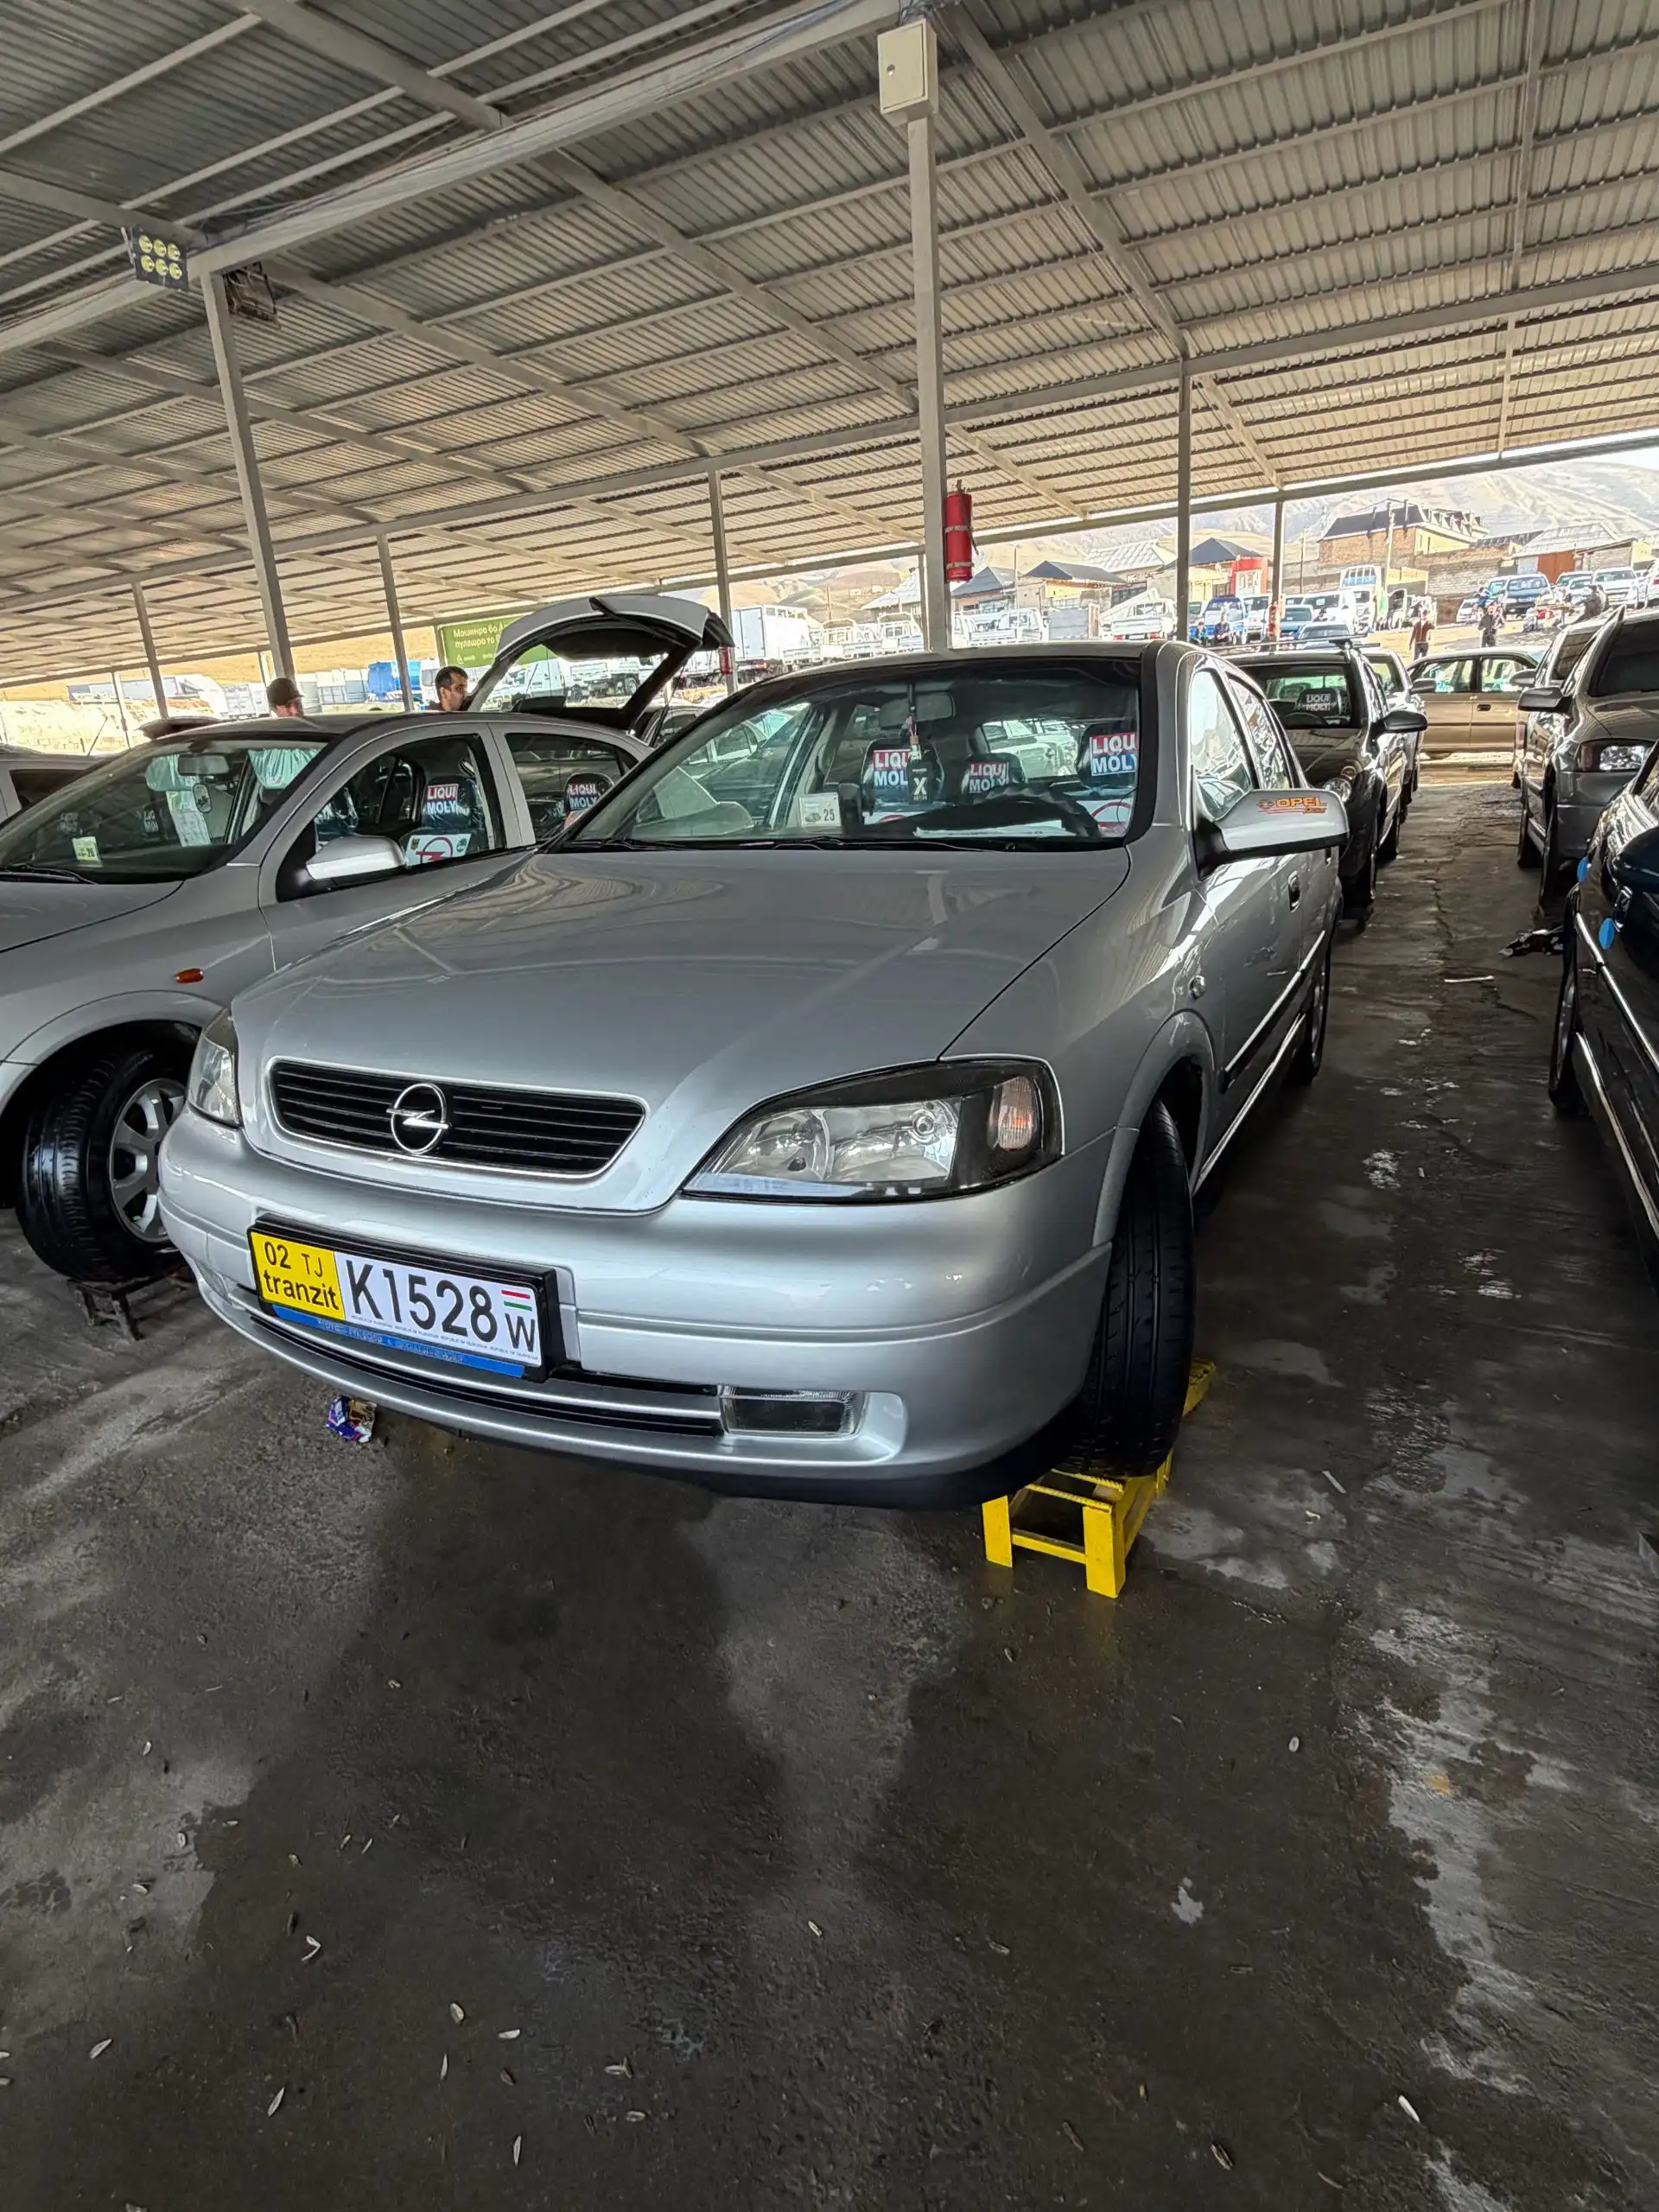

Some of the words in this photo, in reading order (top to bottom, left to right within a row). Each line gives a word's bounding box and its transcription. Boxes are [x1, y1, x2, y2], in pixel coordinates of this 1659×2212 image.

[1092, 734, 1135, 753] LIQU
[874, 752, 911, 769] LIQU
[874, 770, 909, 786] MOL
[427, 785, 457, 799] LIQUI
[426, 800, 457, 815] MOLY
[264, 1241, 291, 1269] 02
[301, 1252, 323, 1279] TJ
[263, 1269, 340, 1312] tranzit
[345, 1259, 499, 1343] K1528
